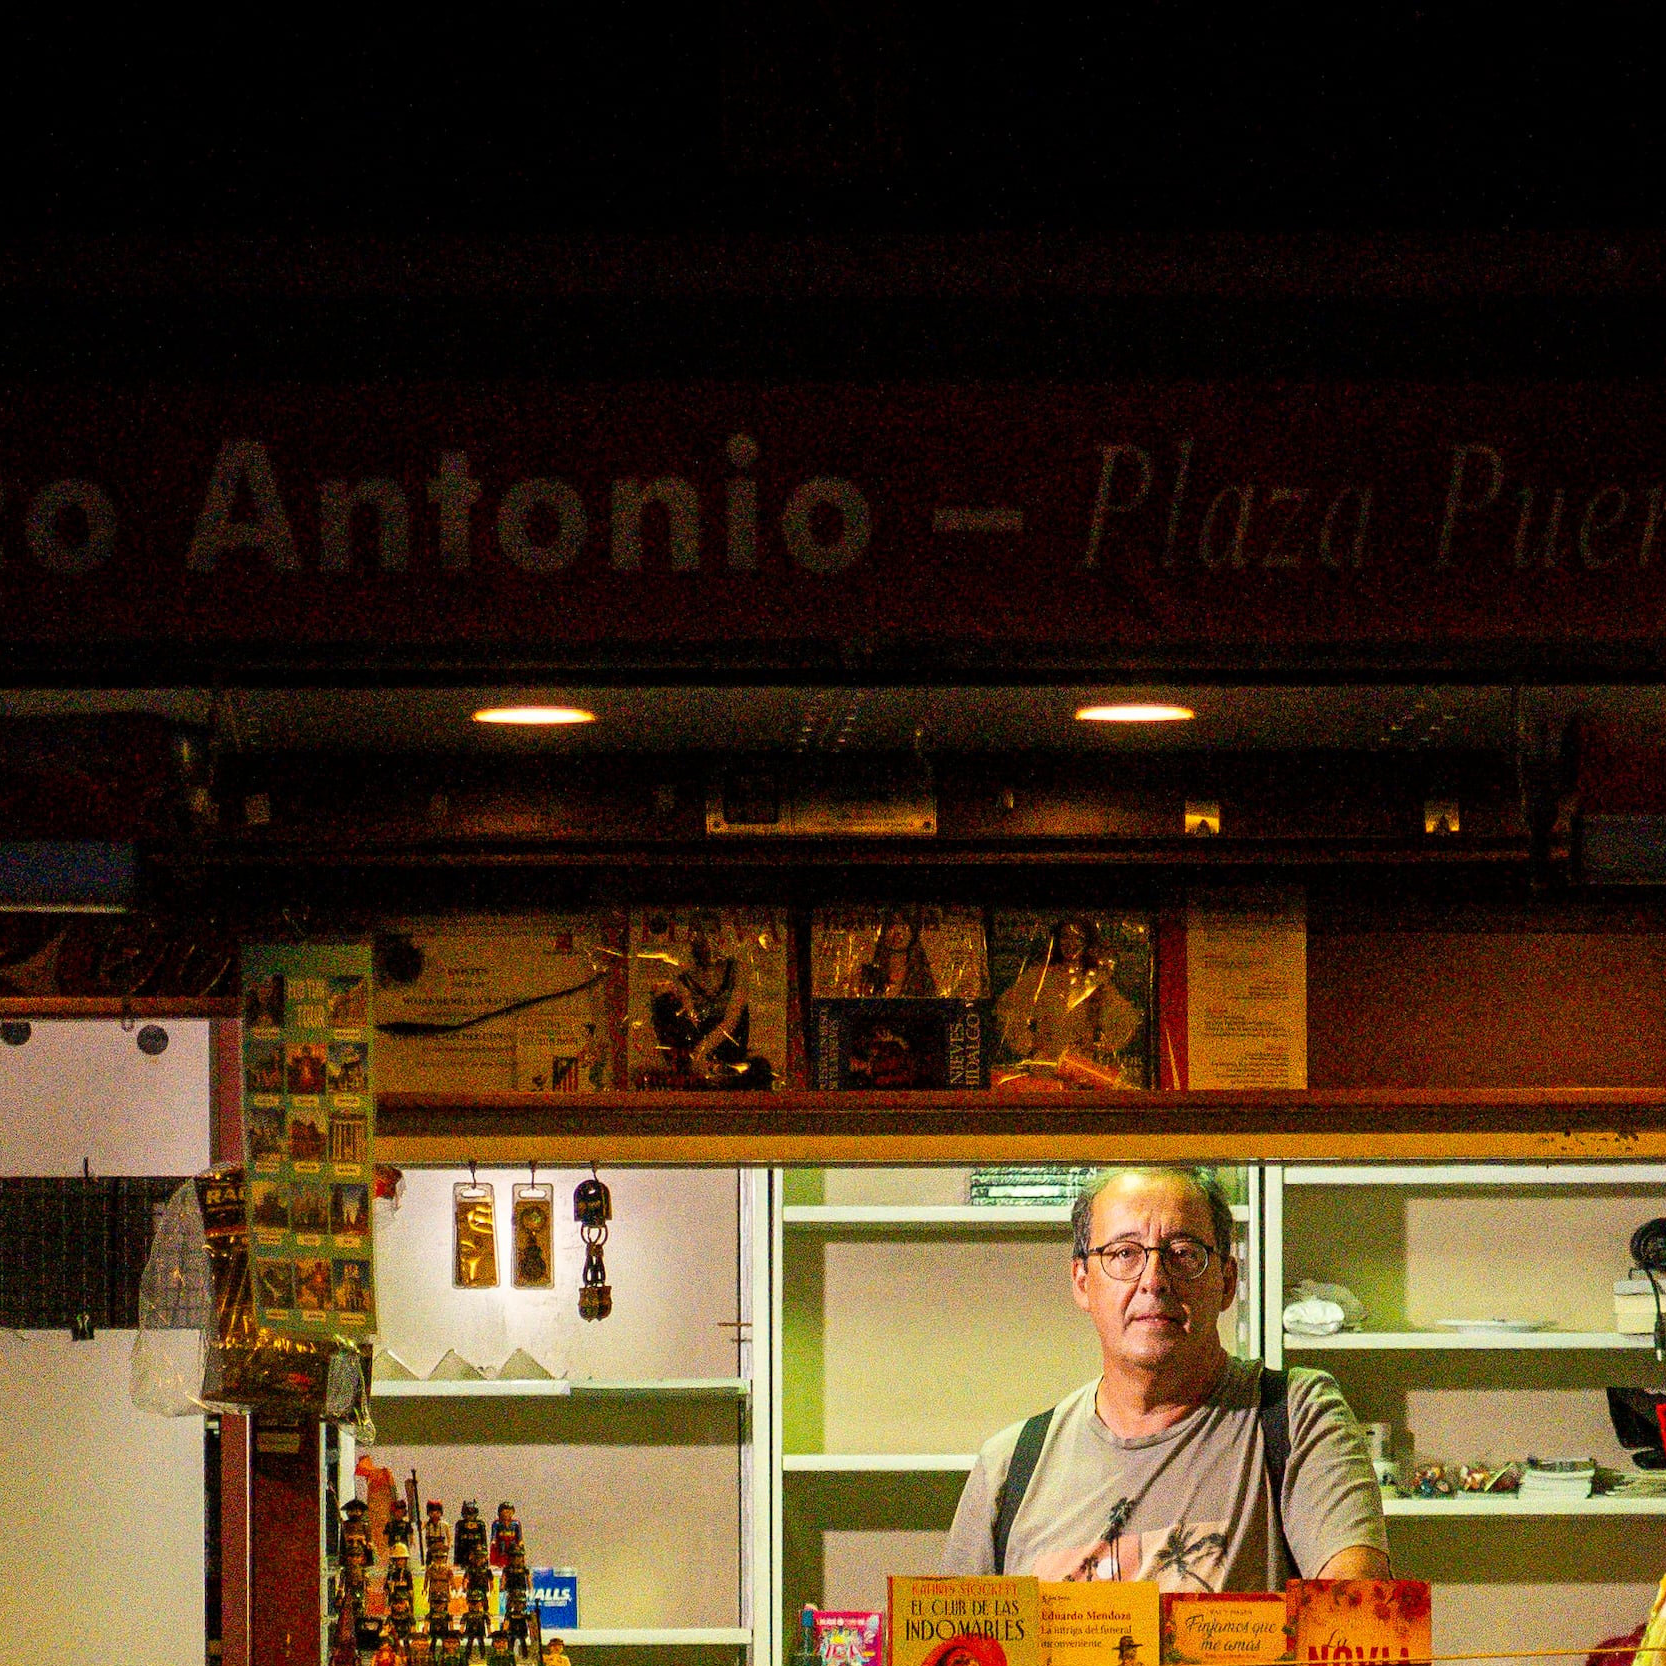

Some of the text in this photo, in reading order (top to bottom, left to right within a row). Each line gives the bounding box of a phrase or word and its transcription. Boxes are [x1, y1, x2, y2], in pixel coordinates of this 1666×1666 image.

[185, 430, 870, 575] Antonio
[1080, 439, 1375, 575] Plaza
[911, 1599, 1019, 1616] EL CLUB DE LAS
[1042, 1611, 1131, 1621] Eduardo Mendoza
[906, 1619, 1025, 1641] INDOMABLES
[1185, 1613, 1276, 1640] Finjamos que
[1200, 1640, 1220, 1651] me
